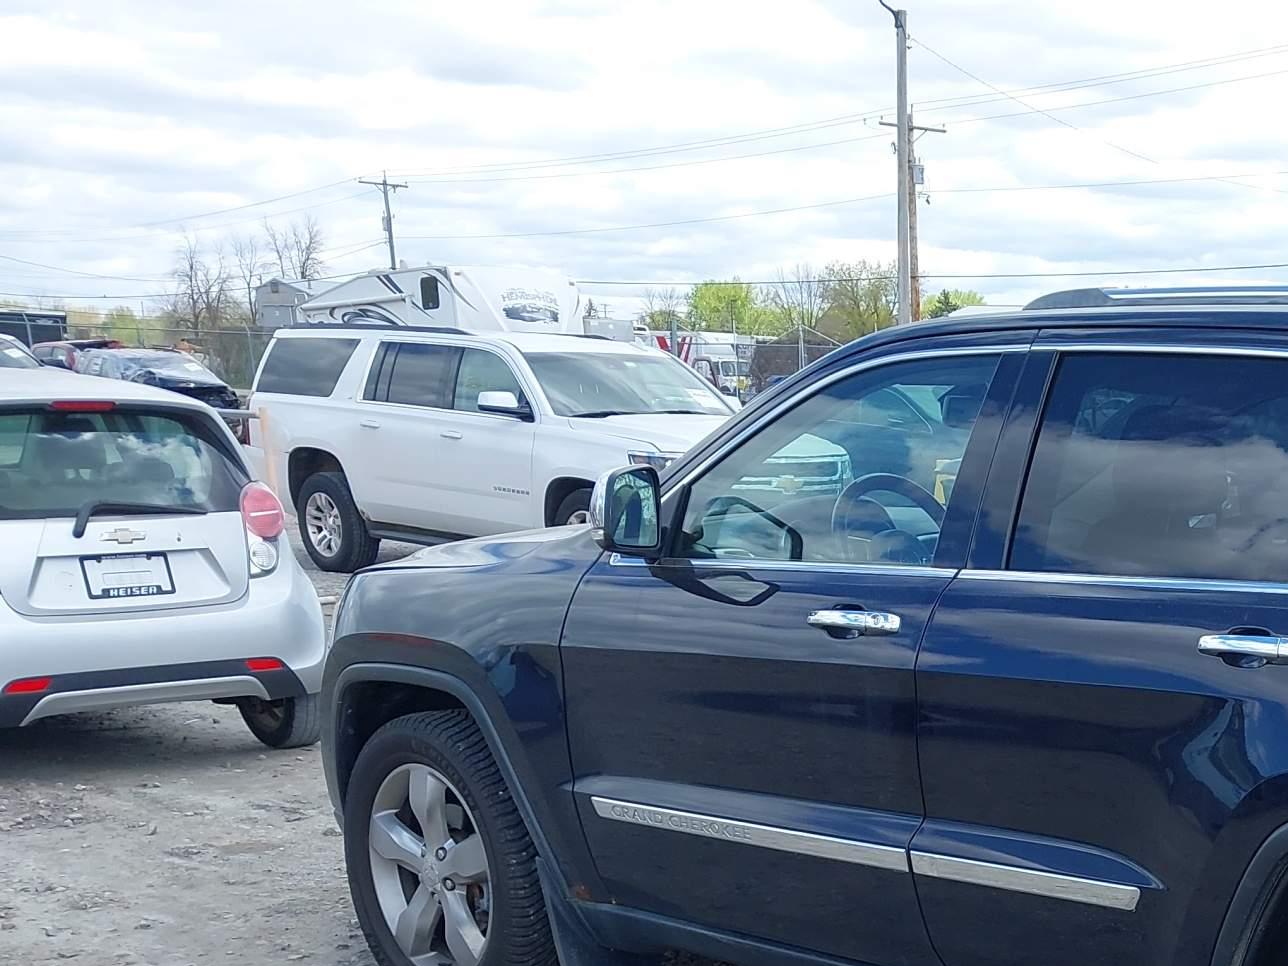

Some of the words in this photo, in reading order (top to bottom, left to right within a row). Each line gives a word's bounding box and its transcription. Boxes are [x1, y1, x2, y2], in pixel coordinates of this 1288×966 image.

[109, 585, 157, 597] HEISER
[611, 804, 663, 825] GRAND
[668, 814, 752, 841] CHEROKEE
